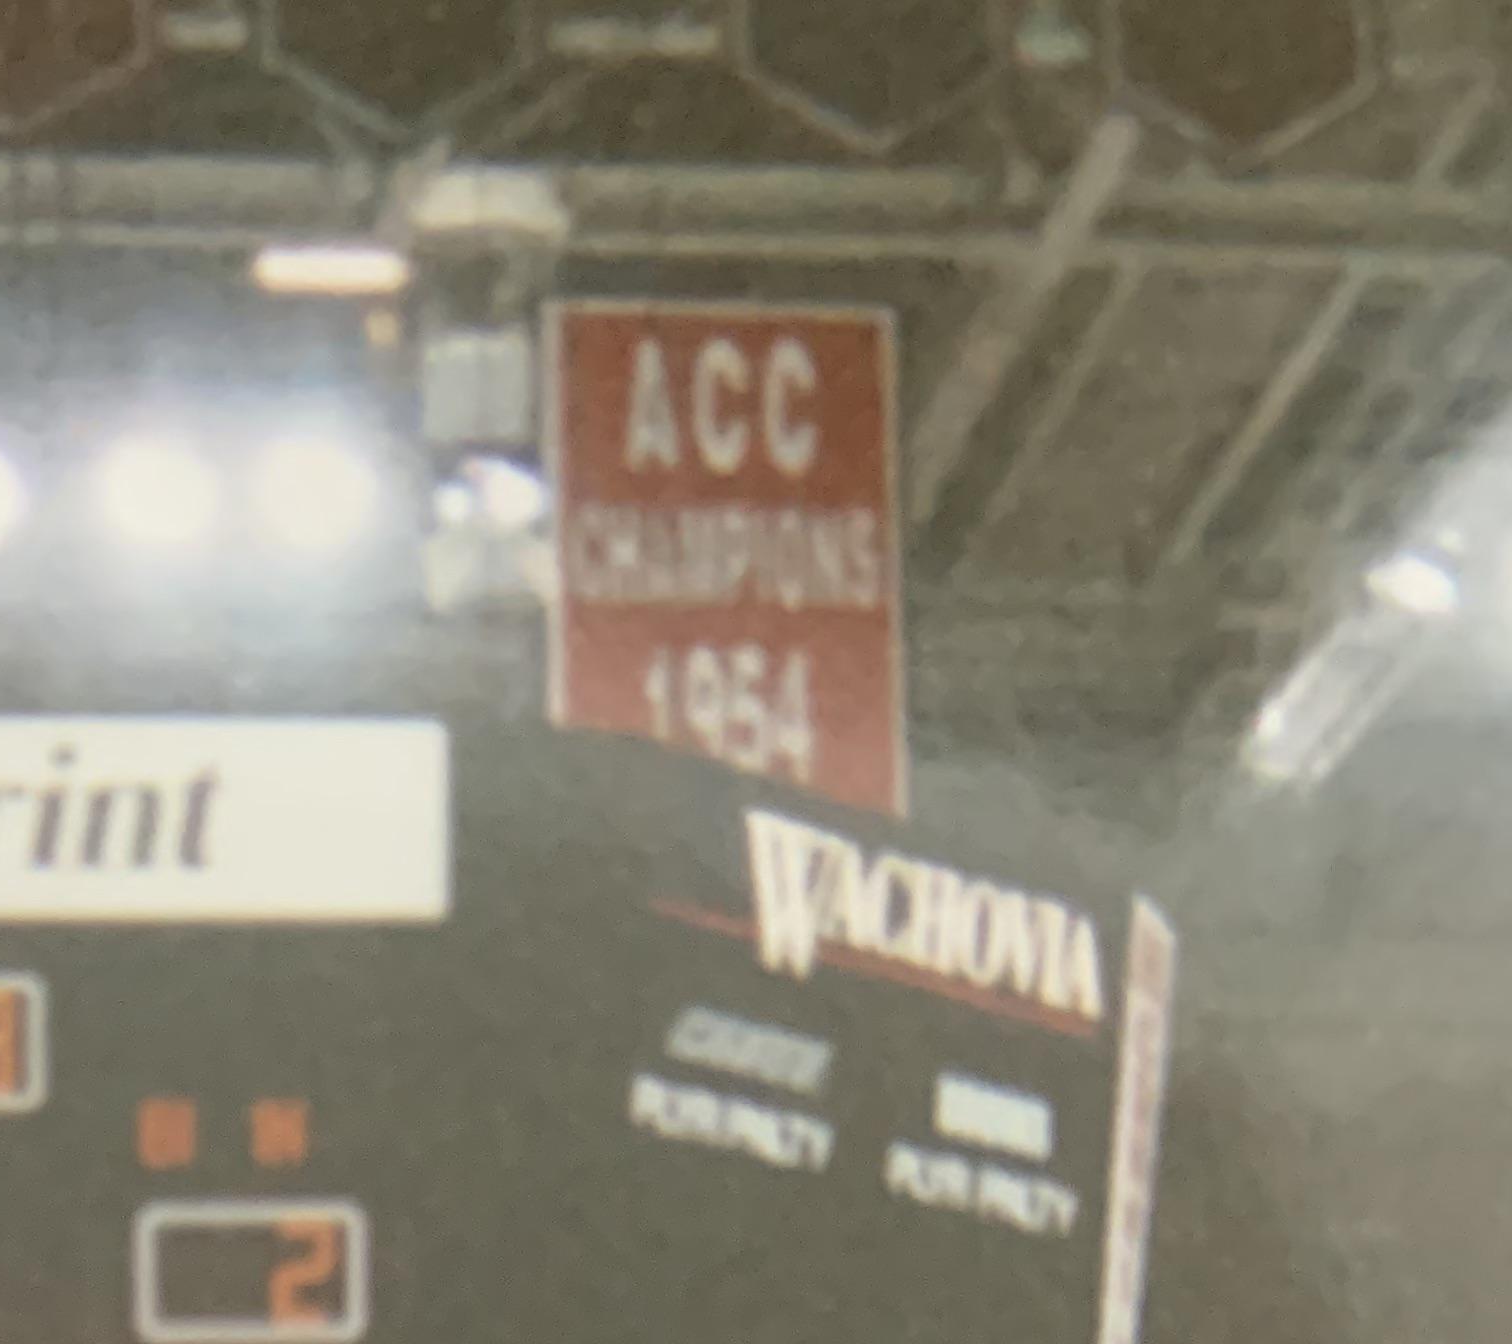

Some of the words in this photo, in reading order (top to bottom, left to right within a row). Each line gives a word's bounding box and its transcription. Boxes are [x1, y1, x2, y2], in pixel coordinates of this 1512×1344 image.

[623, 335, 820, 476] ACC
[569, 506, 883, 612] CHAMPIONS
[643, 644, 816, 785] 1954
[743, 807, 1105, 1022] WACHOVIA
[268, 1214, 340, 1328] 2
